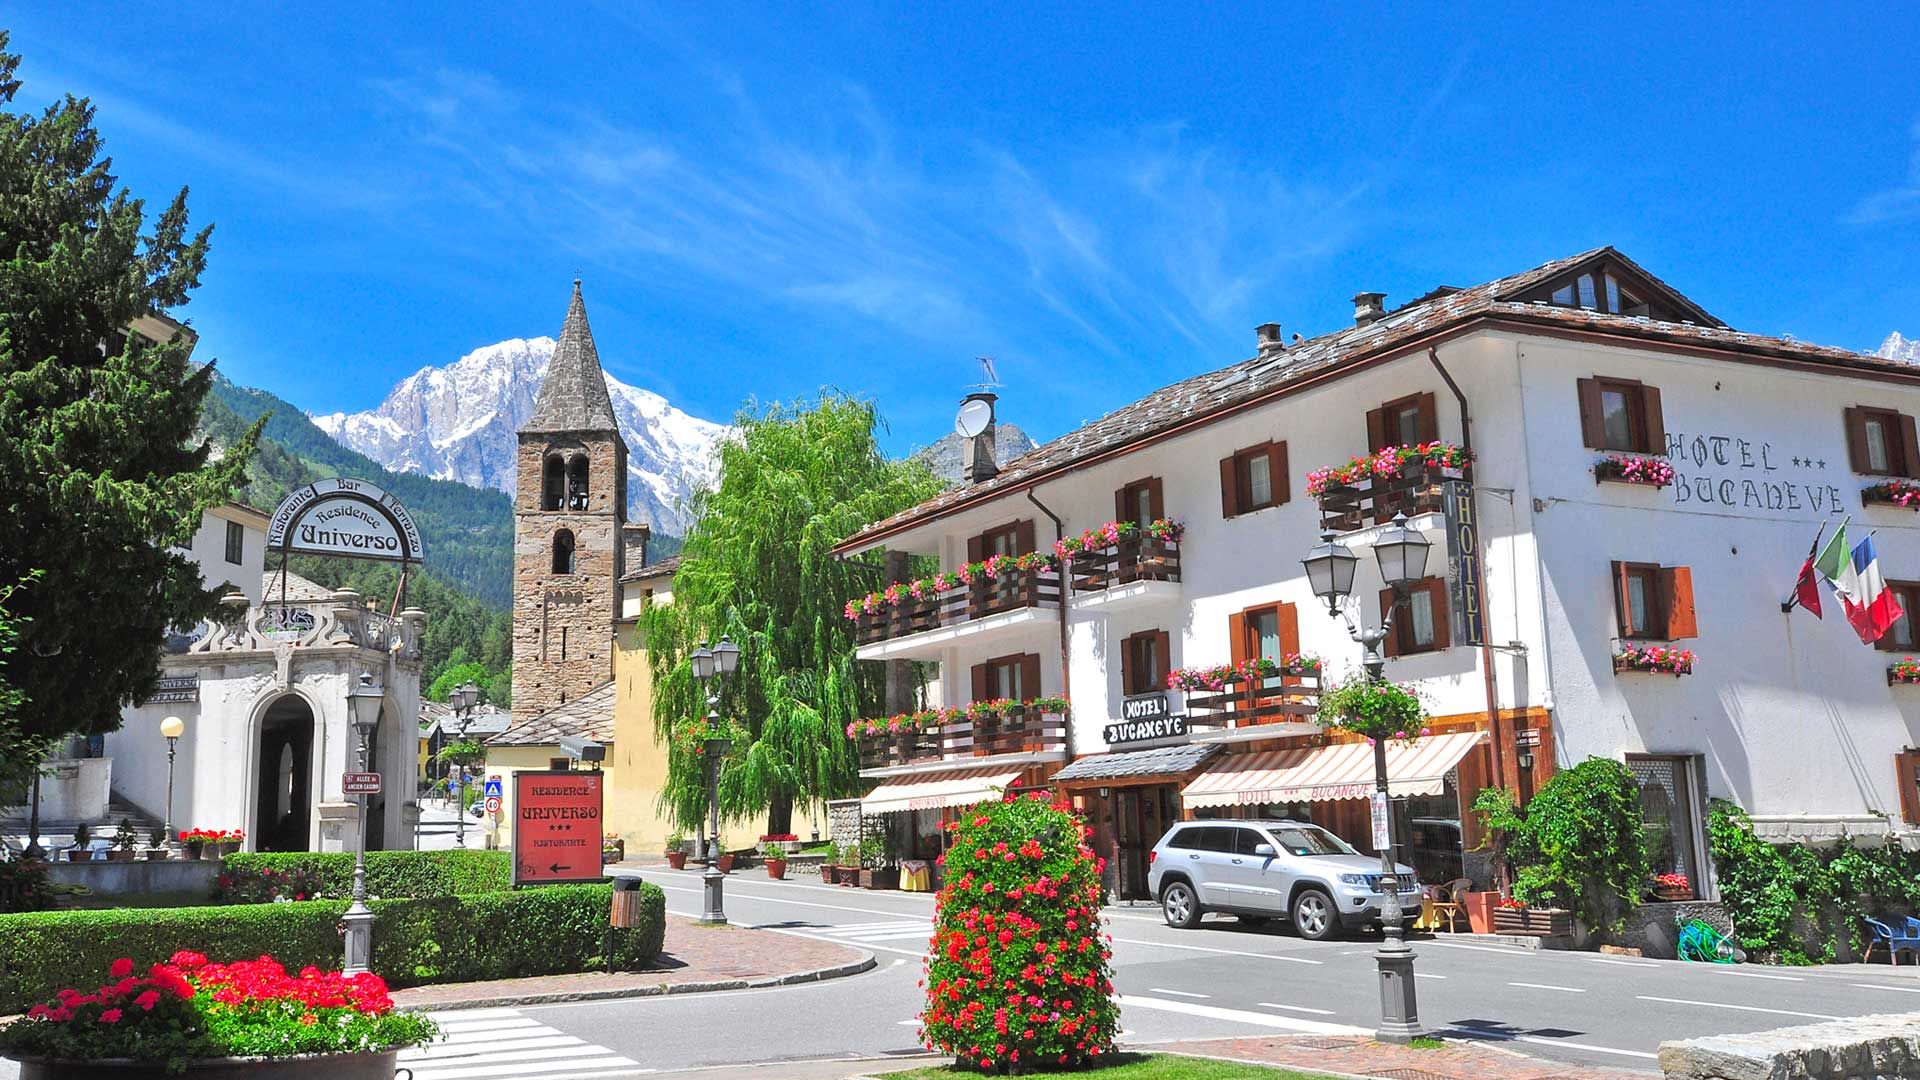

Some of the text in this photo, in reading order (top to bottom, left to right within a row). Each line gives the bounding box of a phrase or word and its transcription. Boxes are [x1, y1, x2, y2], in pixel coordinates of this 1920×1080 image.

[1665, 432, 1778, 473] HOTEL
[336, 479, 361, 491] Bar
[1675, 473, 1845, 516] BUCANEVE
[269, 488, 313, 545] Ristorante
[315, 505, 381, 529] Residence
[389, 497, 420, 553] Terrazzo
[301, 523, 398, 551] Universo
[1457, 495, 1480, 643] HOTEL
[1126, 699, 1161, 718] HOTEL
[1109, 718, 1182, 742] BUCANEVE
[531, 787, 590, 796] RESIDENCE
[1237, 783, 1371, 803] HOTEL BUCANEVE
[522, 807, 598, 819] UNIVERSO
